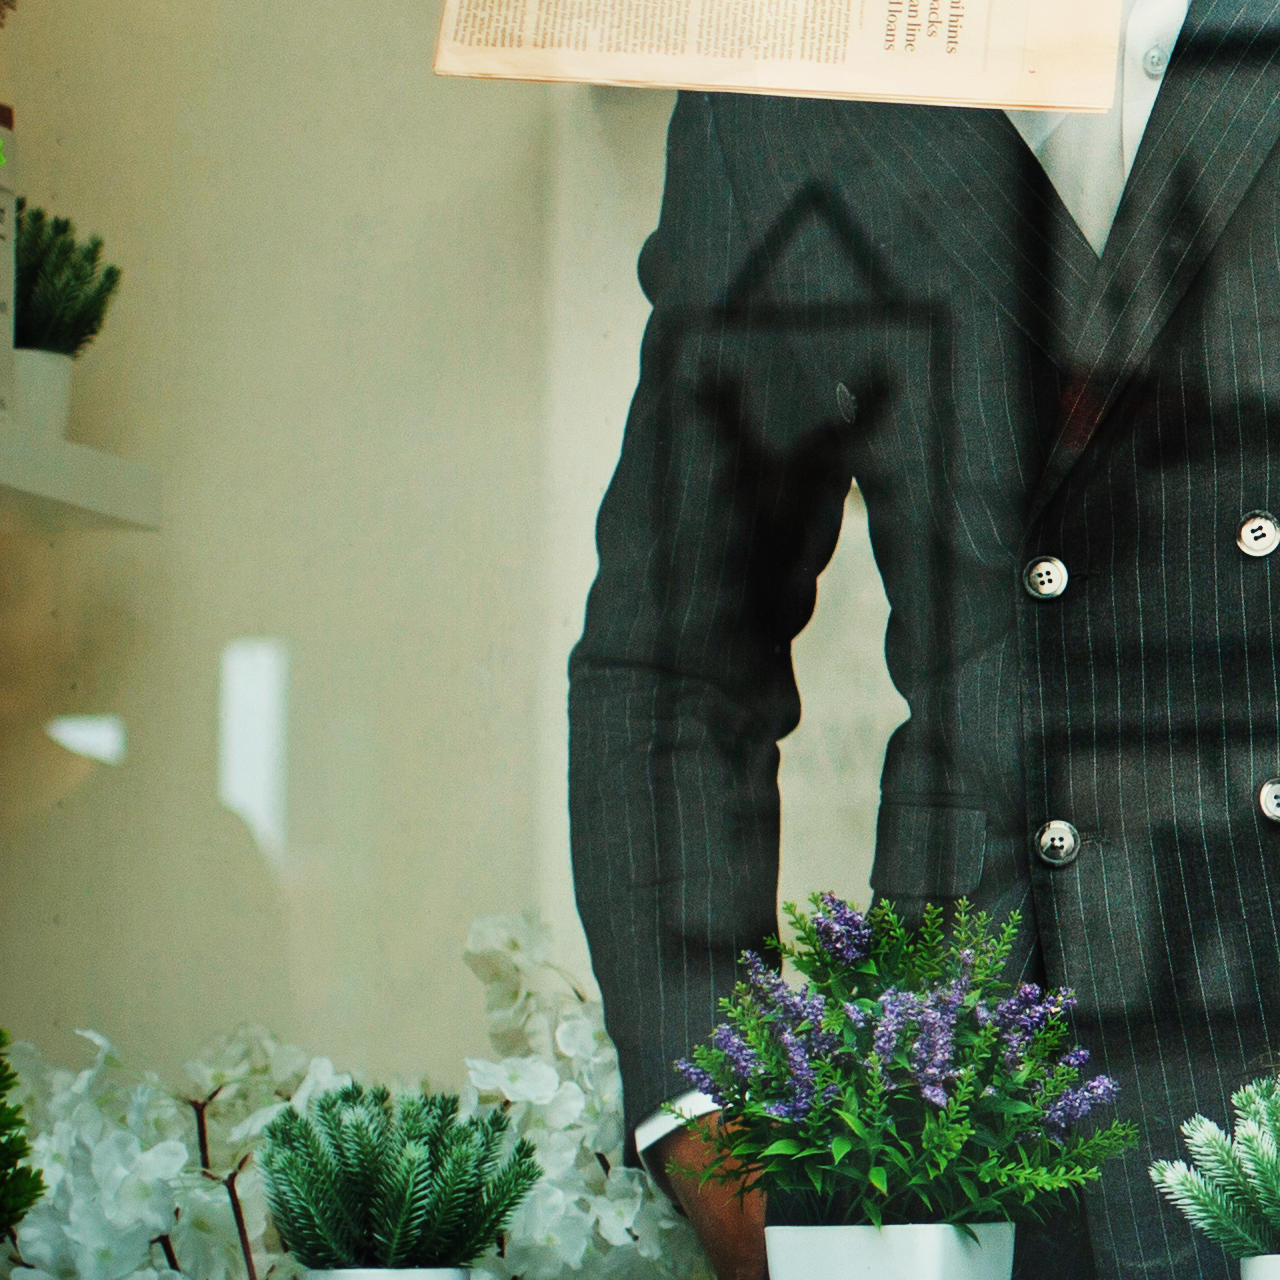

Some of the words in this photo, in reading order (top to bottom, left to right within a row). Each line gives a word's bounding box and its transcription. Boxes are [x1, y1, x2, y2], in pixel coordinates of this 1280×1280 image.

[884, 9, 903, 52] loans
[904, 22, 922, 53] line
[946, 12, 965, 54] hints
